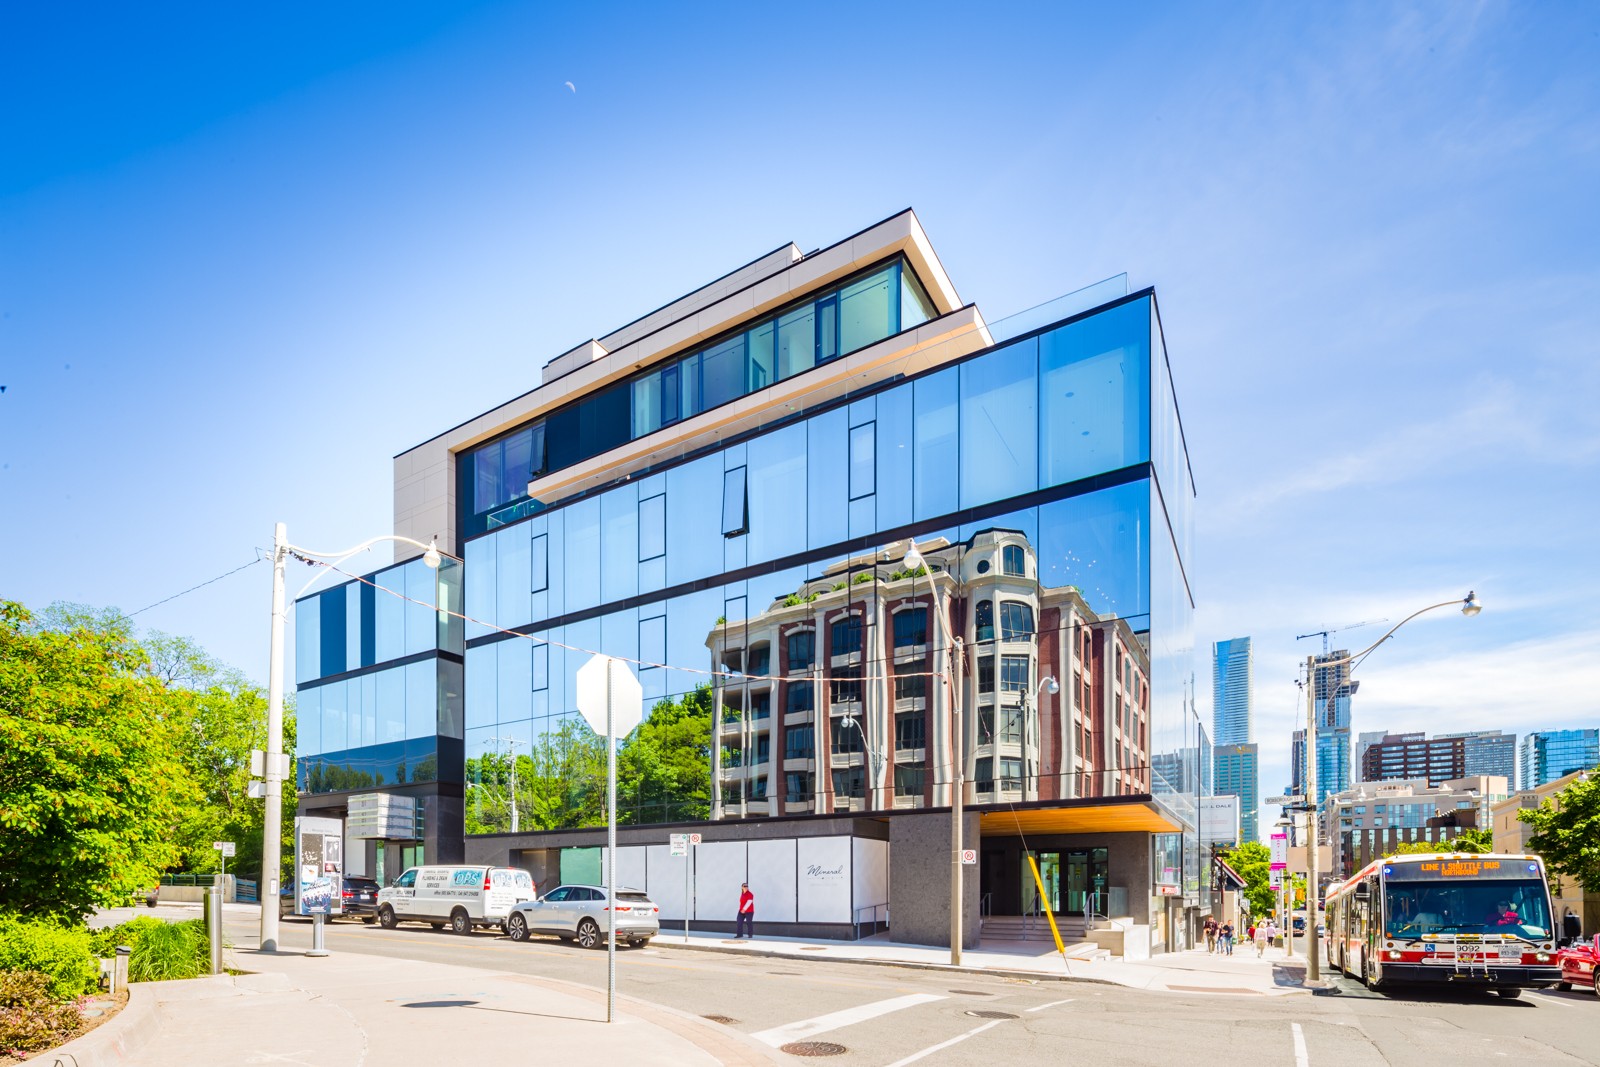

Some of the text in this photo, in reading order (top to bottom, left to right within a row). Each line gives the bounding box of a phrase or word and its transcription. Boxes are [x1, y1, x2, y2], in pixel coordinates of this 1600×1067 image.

[807, 864, 843, 876] Mineral
[1421, 863, 1439, 871] LINE
[1447, 862, 1481, 870] SHUTTLE
[1483, 861, 1500, 869] BUS
